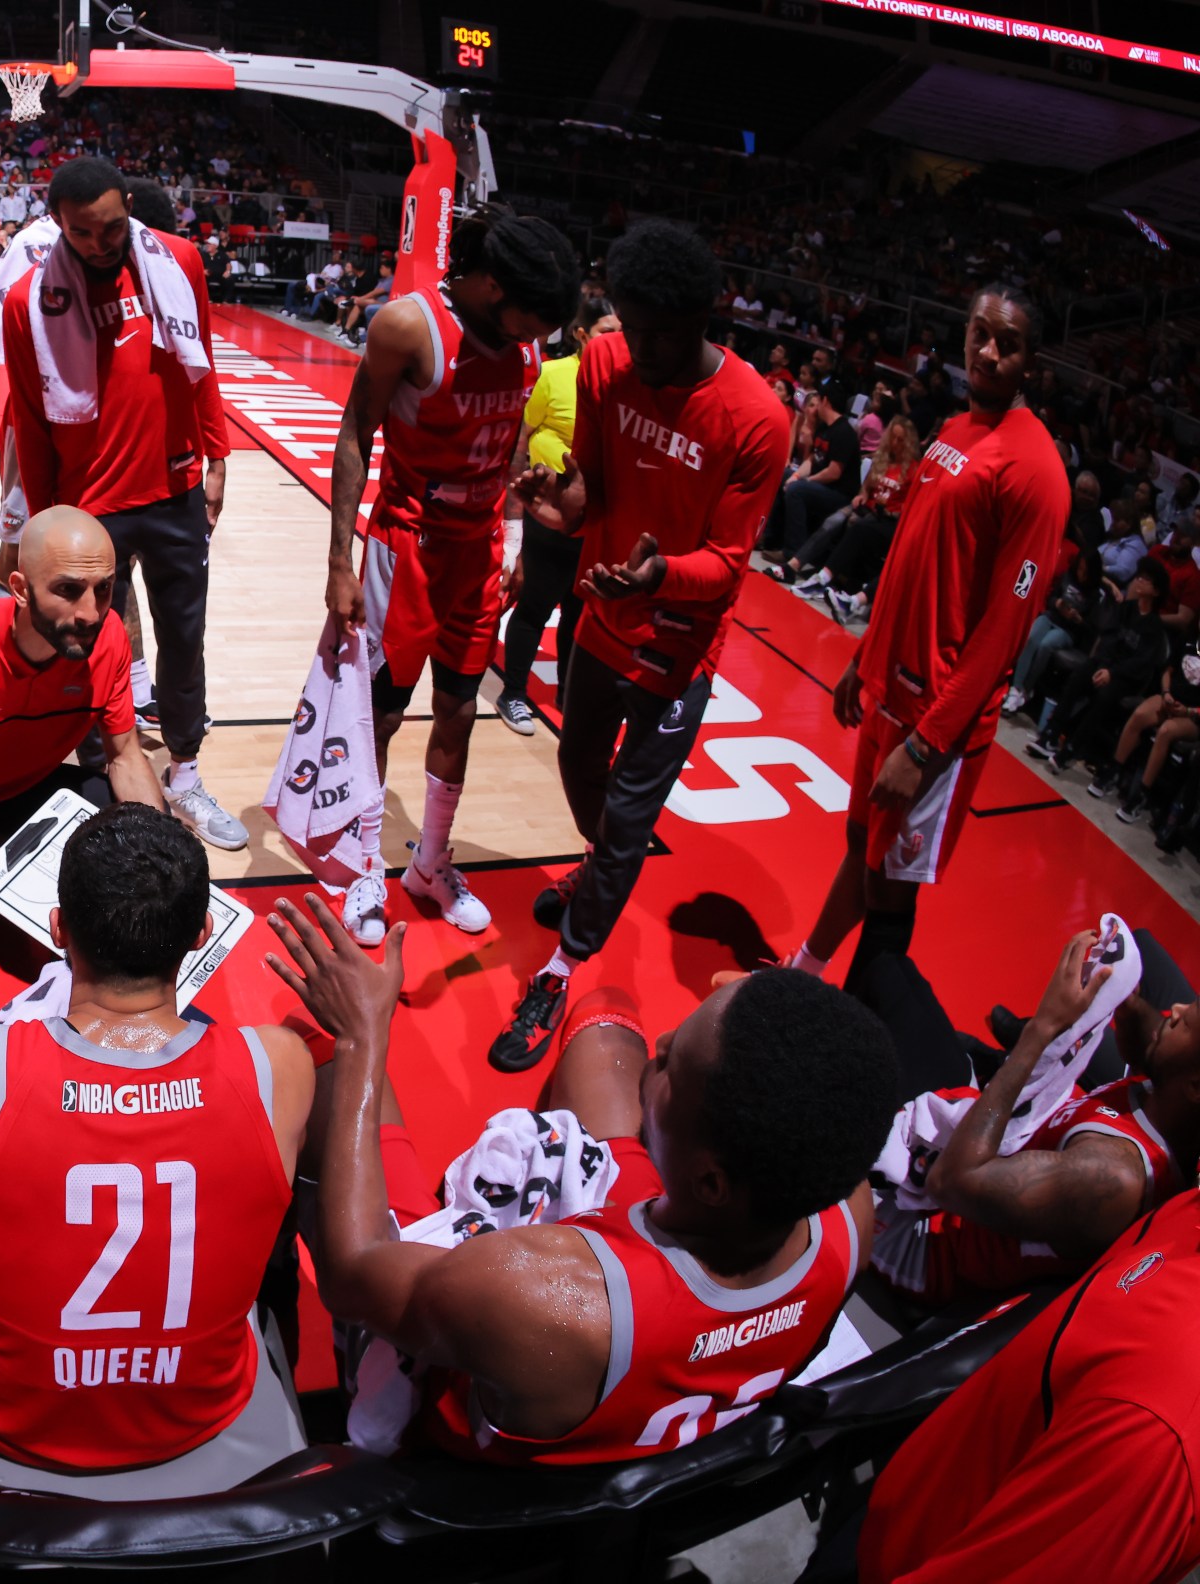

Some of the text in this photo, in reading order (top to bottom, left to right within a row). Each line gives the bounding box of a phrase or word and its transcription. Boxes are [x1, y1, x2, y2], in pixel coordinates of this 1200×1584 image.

[454, 27, 491, 48] 10:05
[936, 8, 970, 25] LEAH
[972, 15, 1004, 32] WISE
[1012, 22, 1039, 41] (956)
[1042, 29, 1104, 52] ABOGADA
[458, 45, 484, 68] 24
[435, 187, 452, 270] @nbagleague
[617, 402, 705, 471] VIPERS
[60, 1160, 197, 1331] 21
[53, 1346, 181, 1389] QUEEN
